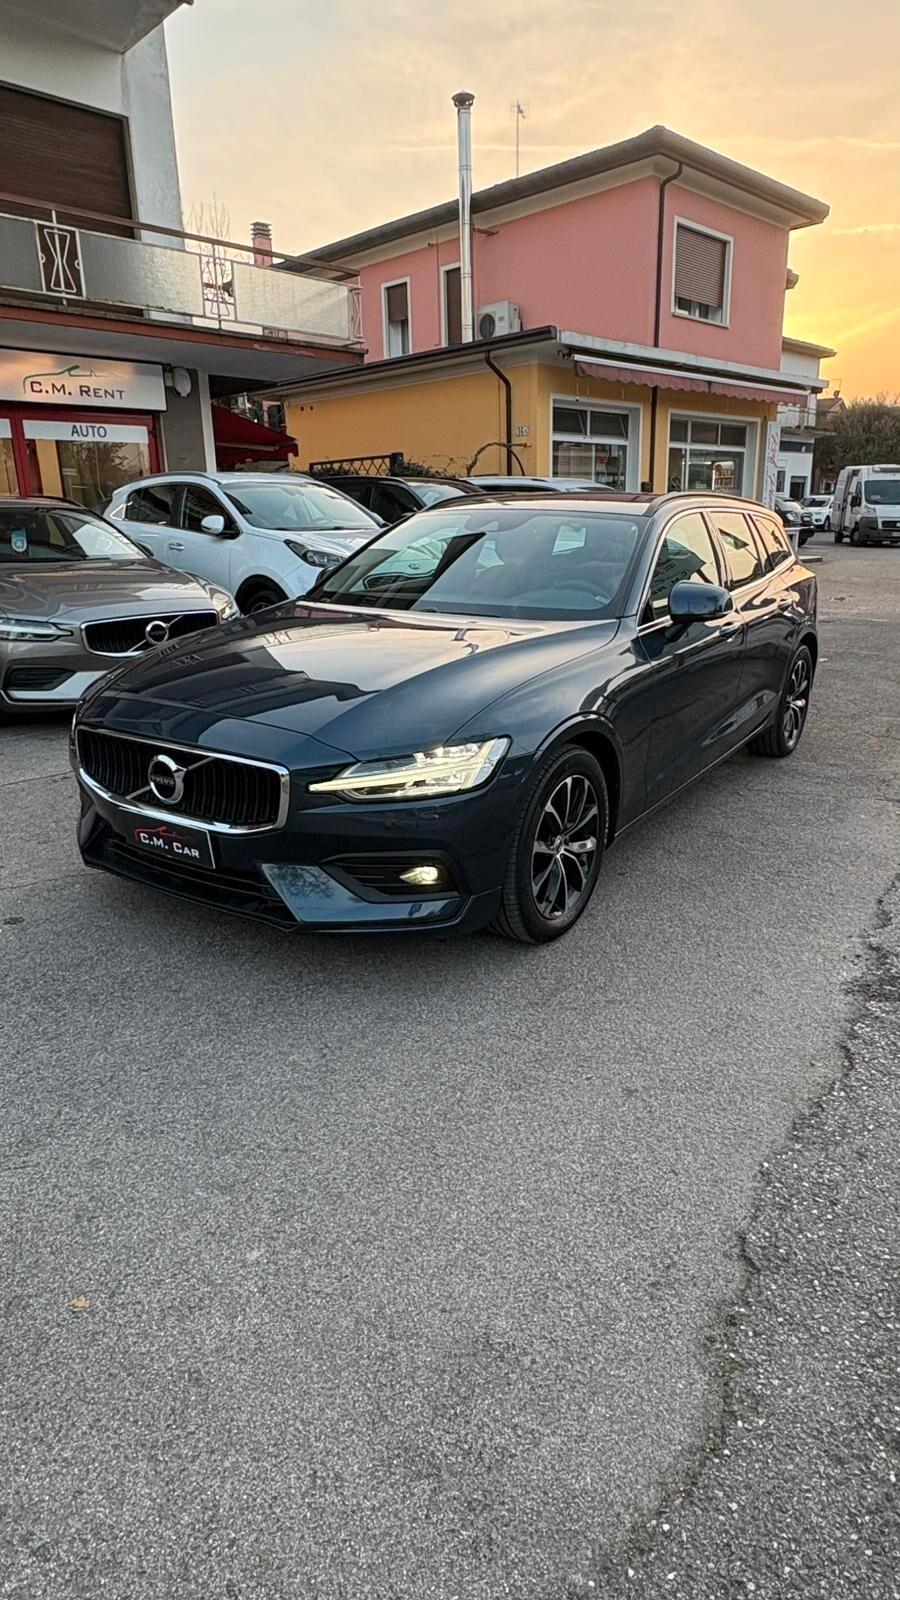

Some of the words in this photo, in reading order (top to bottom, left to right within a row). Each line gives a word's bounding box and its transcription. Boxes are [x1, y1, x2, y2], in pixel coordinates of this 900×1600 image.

[30, 381, 72, 396] C.M.
[79, 385, 125, 400] RENT
[71, 424, 107, 438] AUTO
[150, 775, 175, 785] VOLVO
[140, 833, 169, 849] C.M.
[173, 842, 200, 858] CAR
